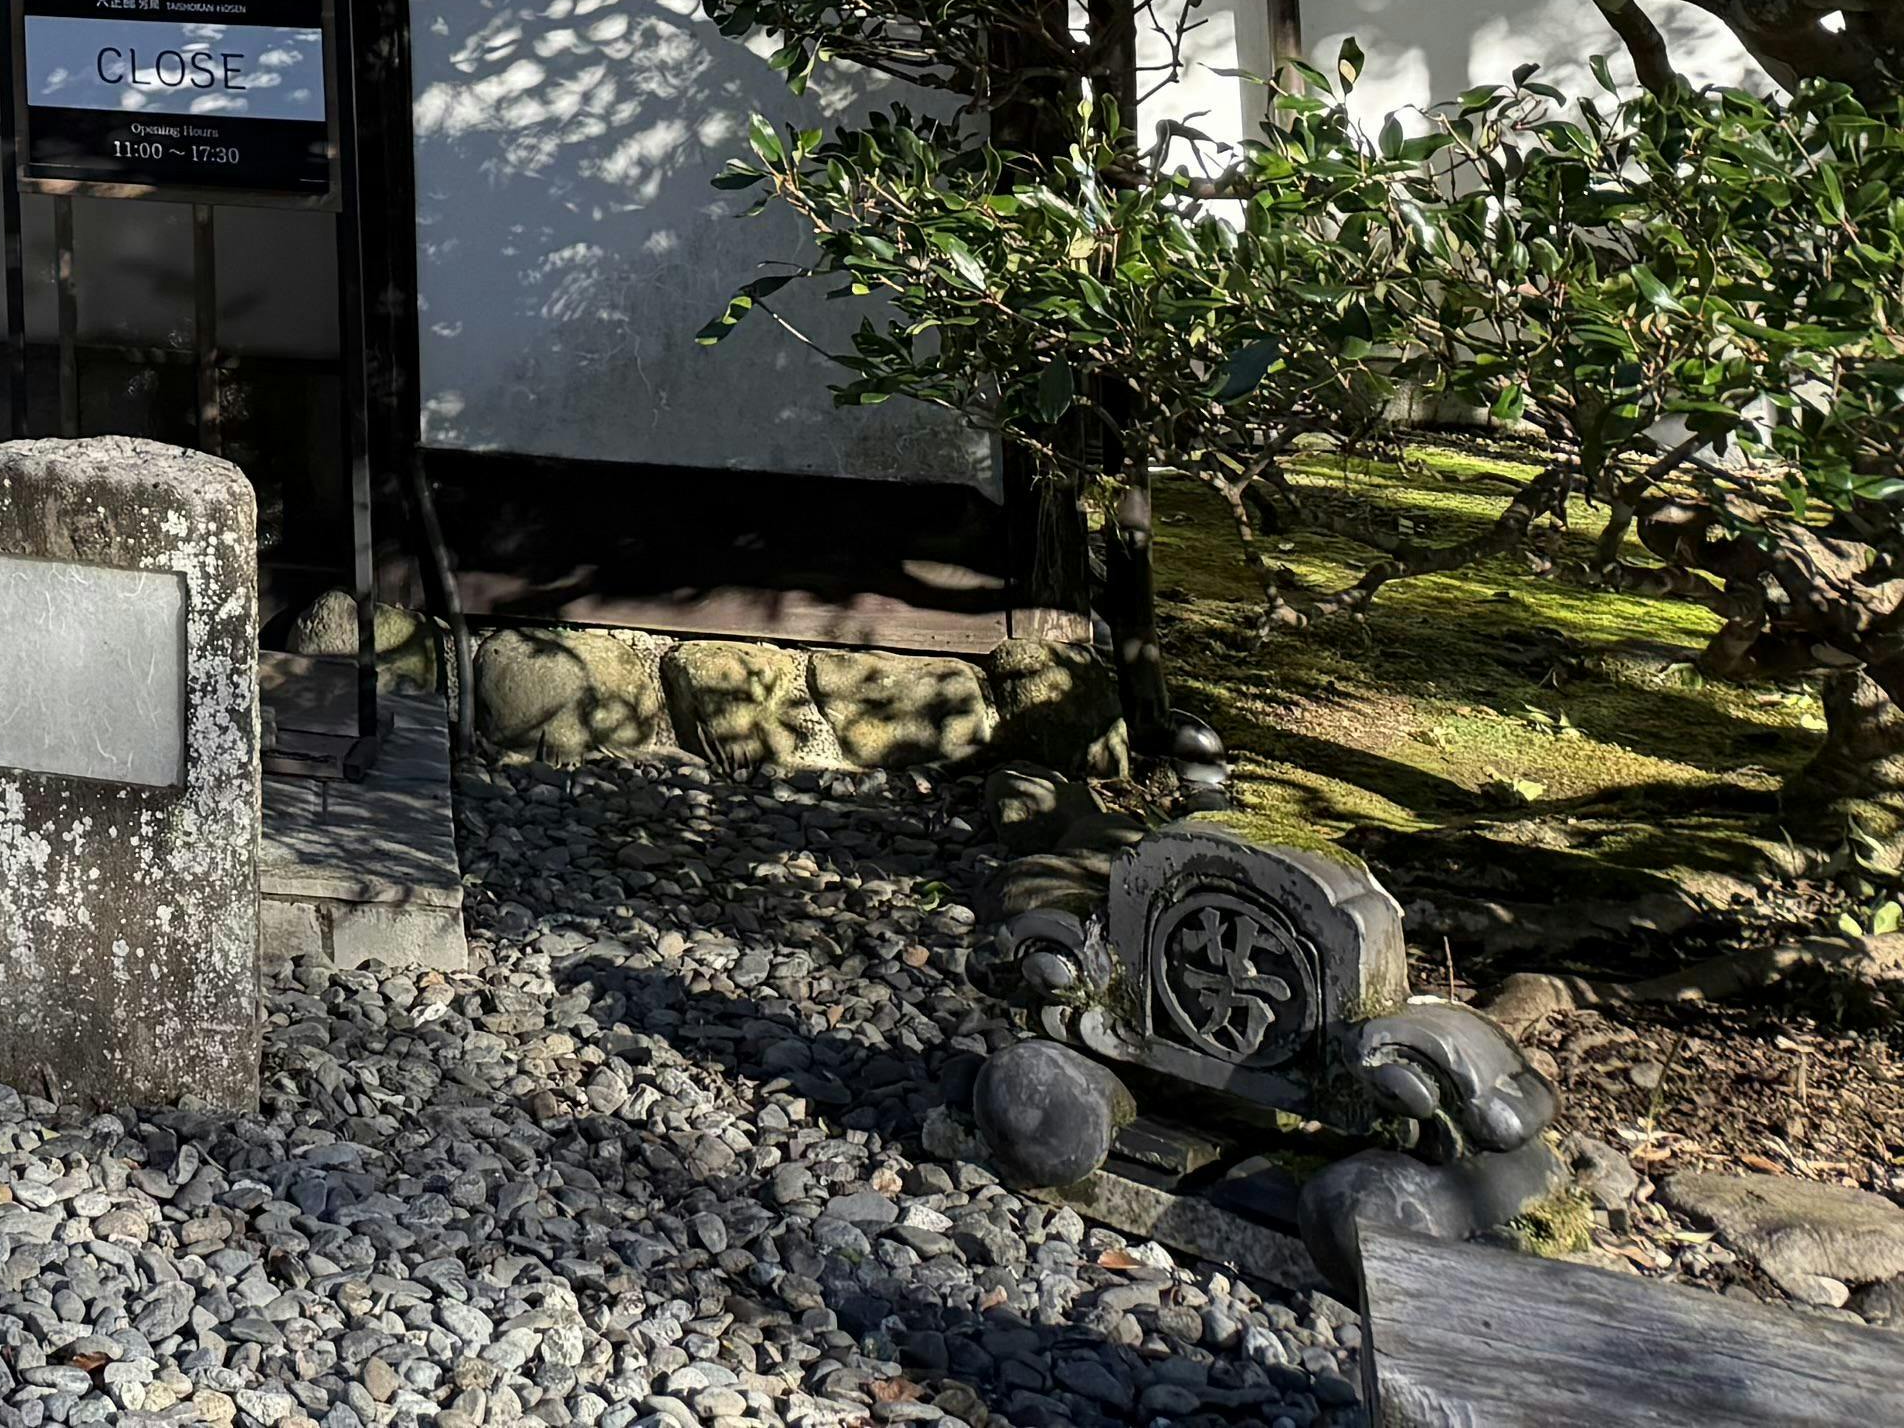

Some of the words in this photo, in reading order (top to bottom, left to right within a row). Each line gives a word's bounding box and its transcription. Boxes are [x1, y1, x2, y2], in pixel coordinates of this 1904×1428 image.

[96, 46, 247, 91] CLOSE
[130, 123, 180, 138] Opening
[183, 125, 219, 137] Hours
[113, 140, 163, 159] 11:00
[191, 145, 239, 164] 17:30
